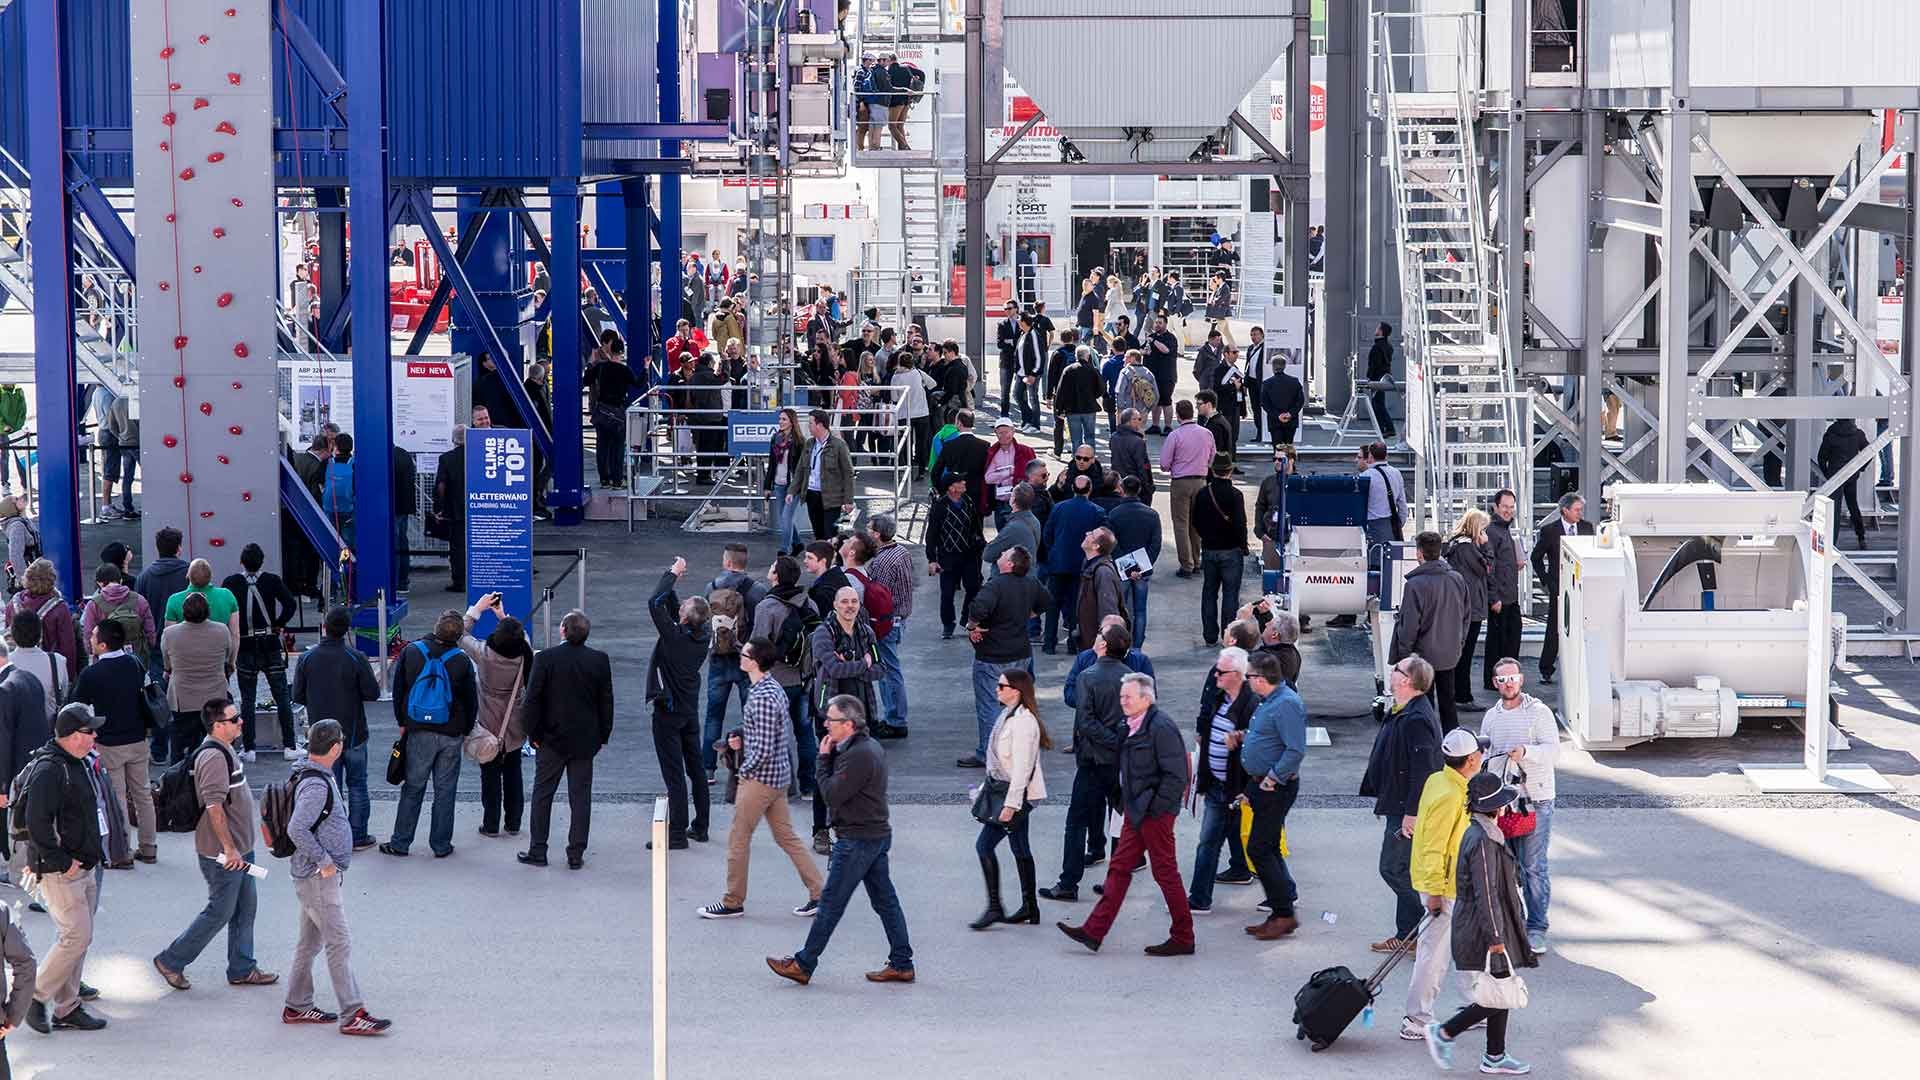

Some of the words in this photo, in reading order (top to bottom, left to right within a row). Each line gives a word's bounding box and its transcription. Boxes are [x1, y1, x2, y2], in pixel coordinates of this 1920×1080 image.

[410, 367, 426, 375] NEU
[429, 367, 447, 375] NEW
[485, 437, 496, 479] CLIMB
[498, 455, 504, 467] TO
[505, 438, 525, 487] TOP
[469, 493, 528, 501] KLETTERWAND
[1305, 575, 1355, 585] AMMANN
